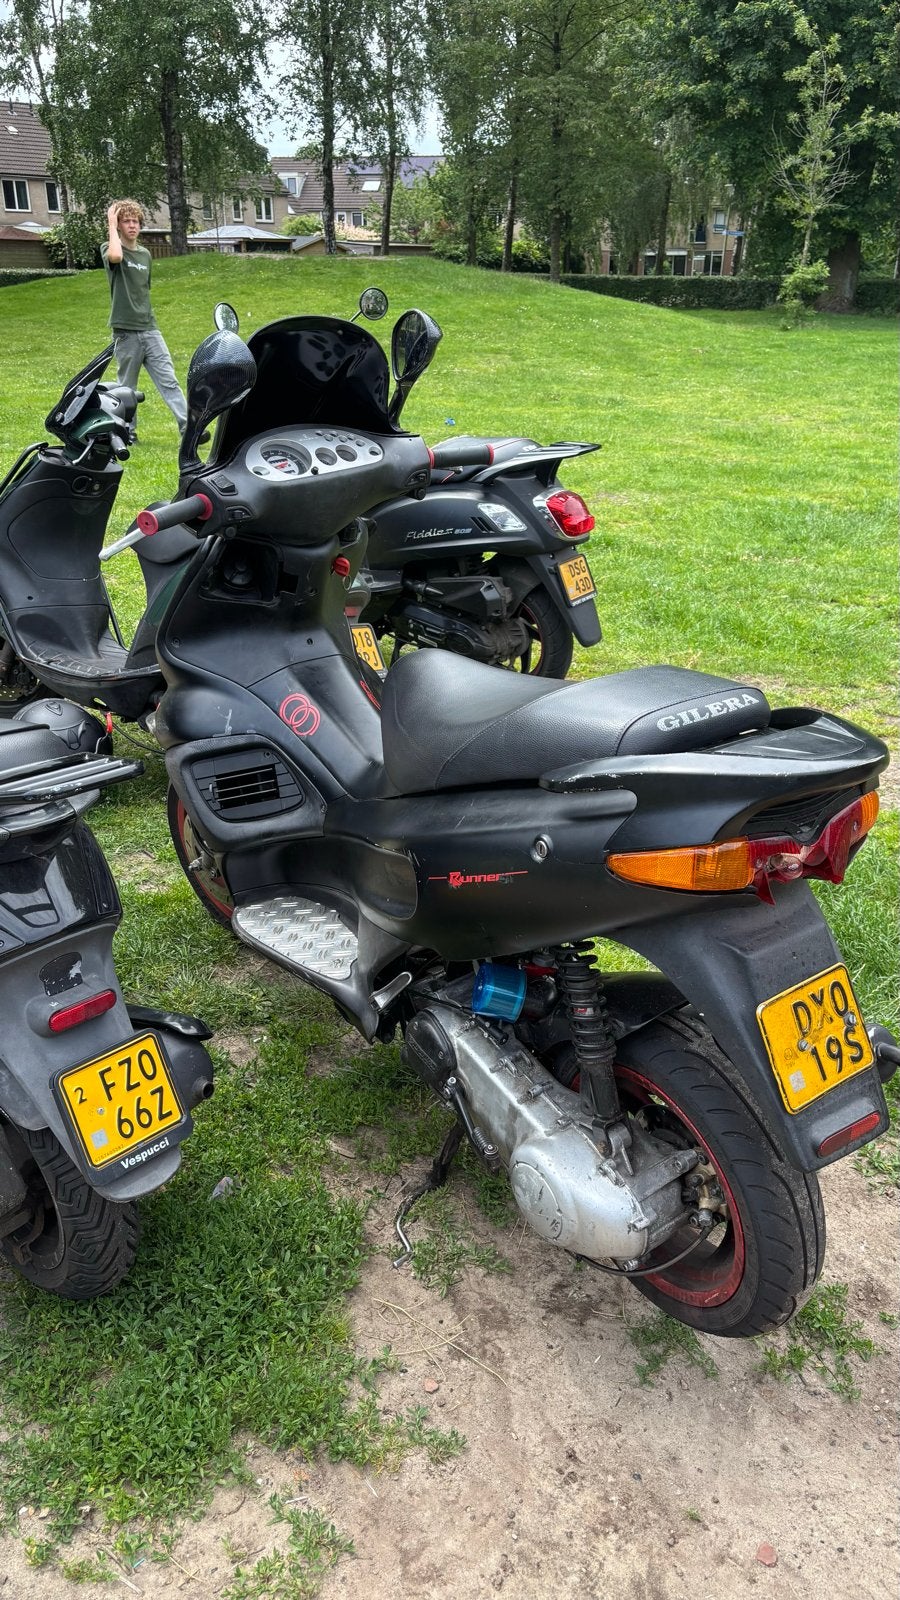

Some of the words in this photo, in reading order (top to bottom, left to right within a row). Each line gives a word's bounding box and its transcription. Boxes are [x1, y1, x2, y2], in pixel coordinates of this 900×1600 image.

[568, 560, 586, 577] DSG
[576, 577, 591, 593] 43D
[657, 694, 759, 731] GILERA
[449, 871, 501, 888] Runner
[811, 1026, 864, 1081] 19S
[74, 1087, 87, 1104] 2
[117, 1085, 172, 1138] 66Z
[121, 1137, 169, 1169] Vespucci
